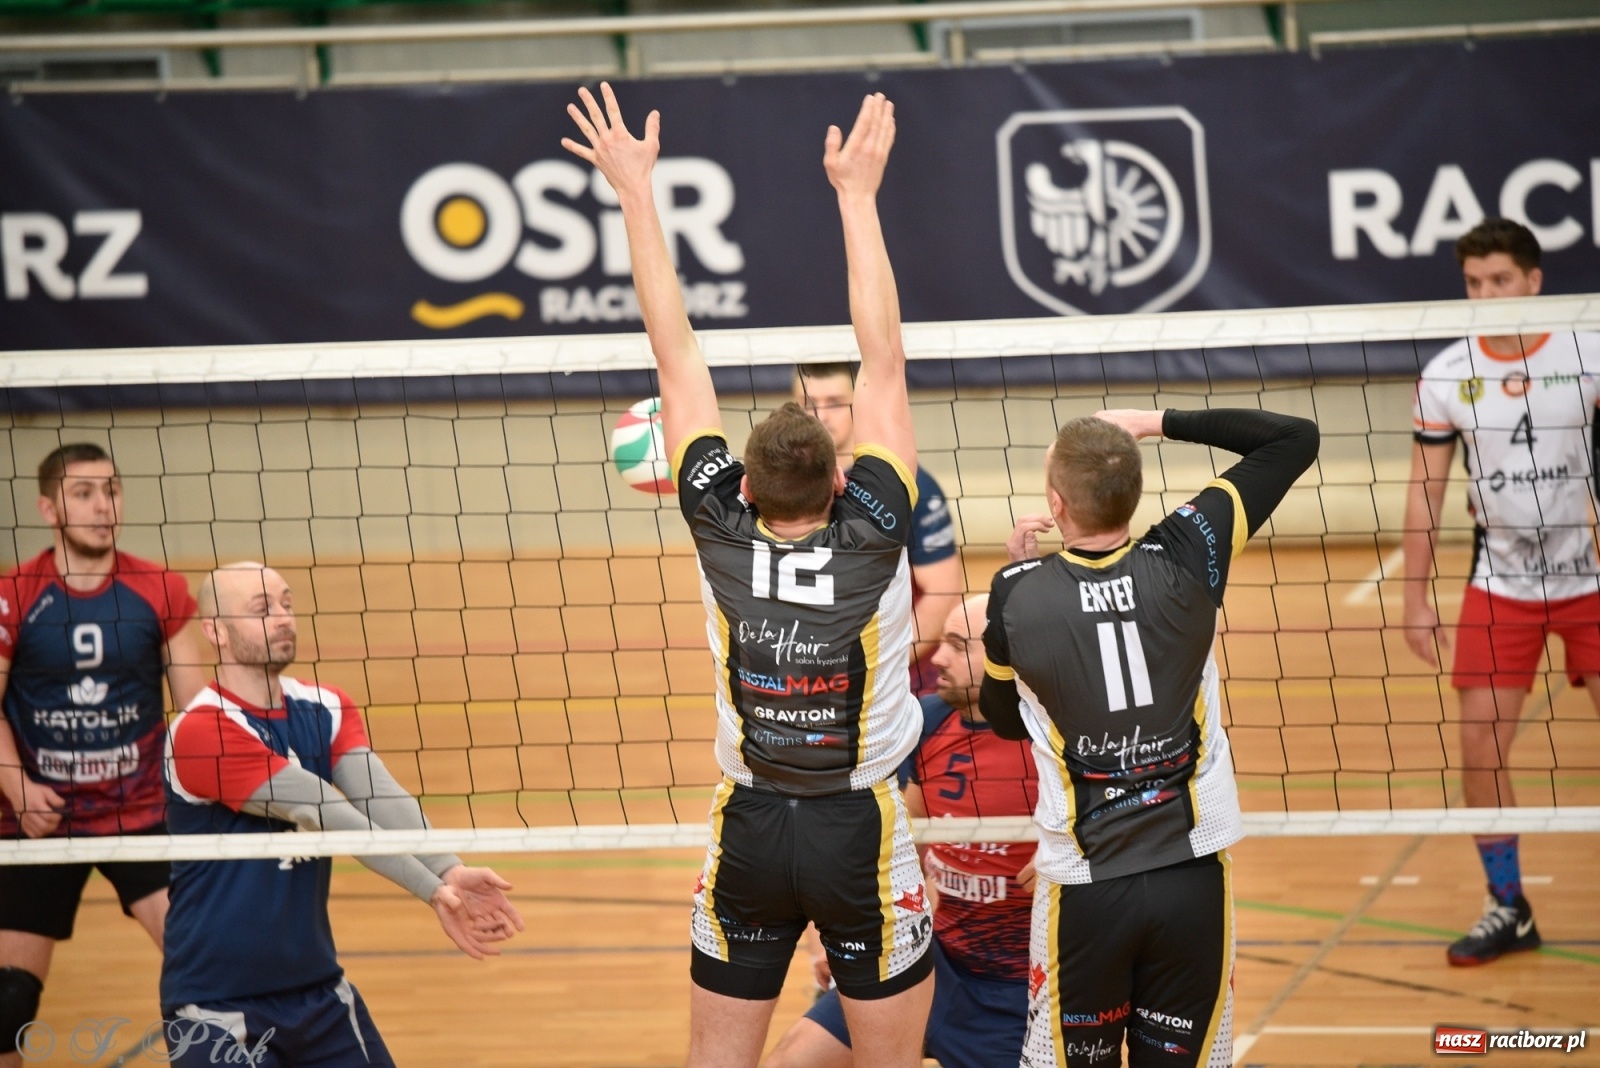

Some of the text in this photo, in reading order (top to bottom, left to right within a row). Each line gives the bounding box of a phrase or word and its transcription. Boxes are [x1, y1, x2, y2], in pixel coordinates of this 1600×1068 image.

[2, 210, 148, 300] RZ
[1510, 412, 1538, 452] 4
[73, 623, 103, 669] 9
[1096, 620, 1154, 712] 11
[34, 705, 139, 730] KATOLIK
[753, 706, 836, 722] GRAVTON
[754, 730, 803, 746] GTrans
[938, 752, 972, 801] 5
